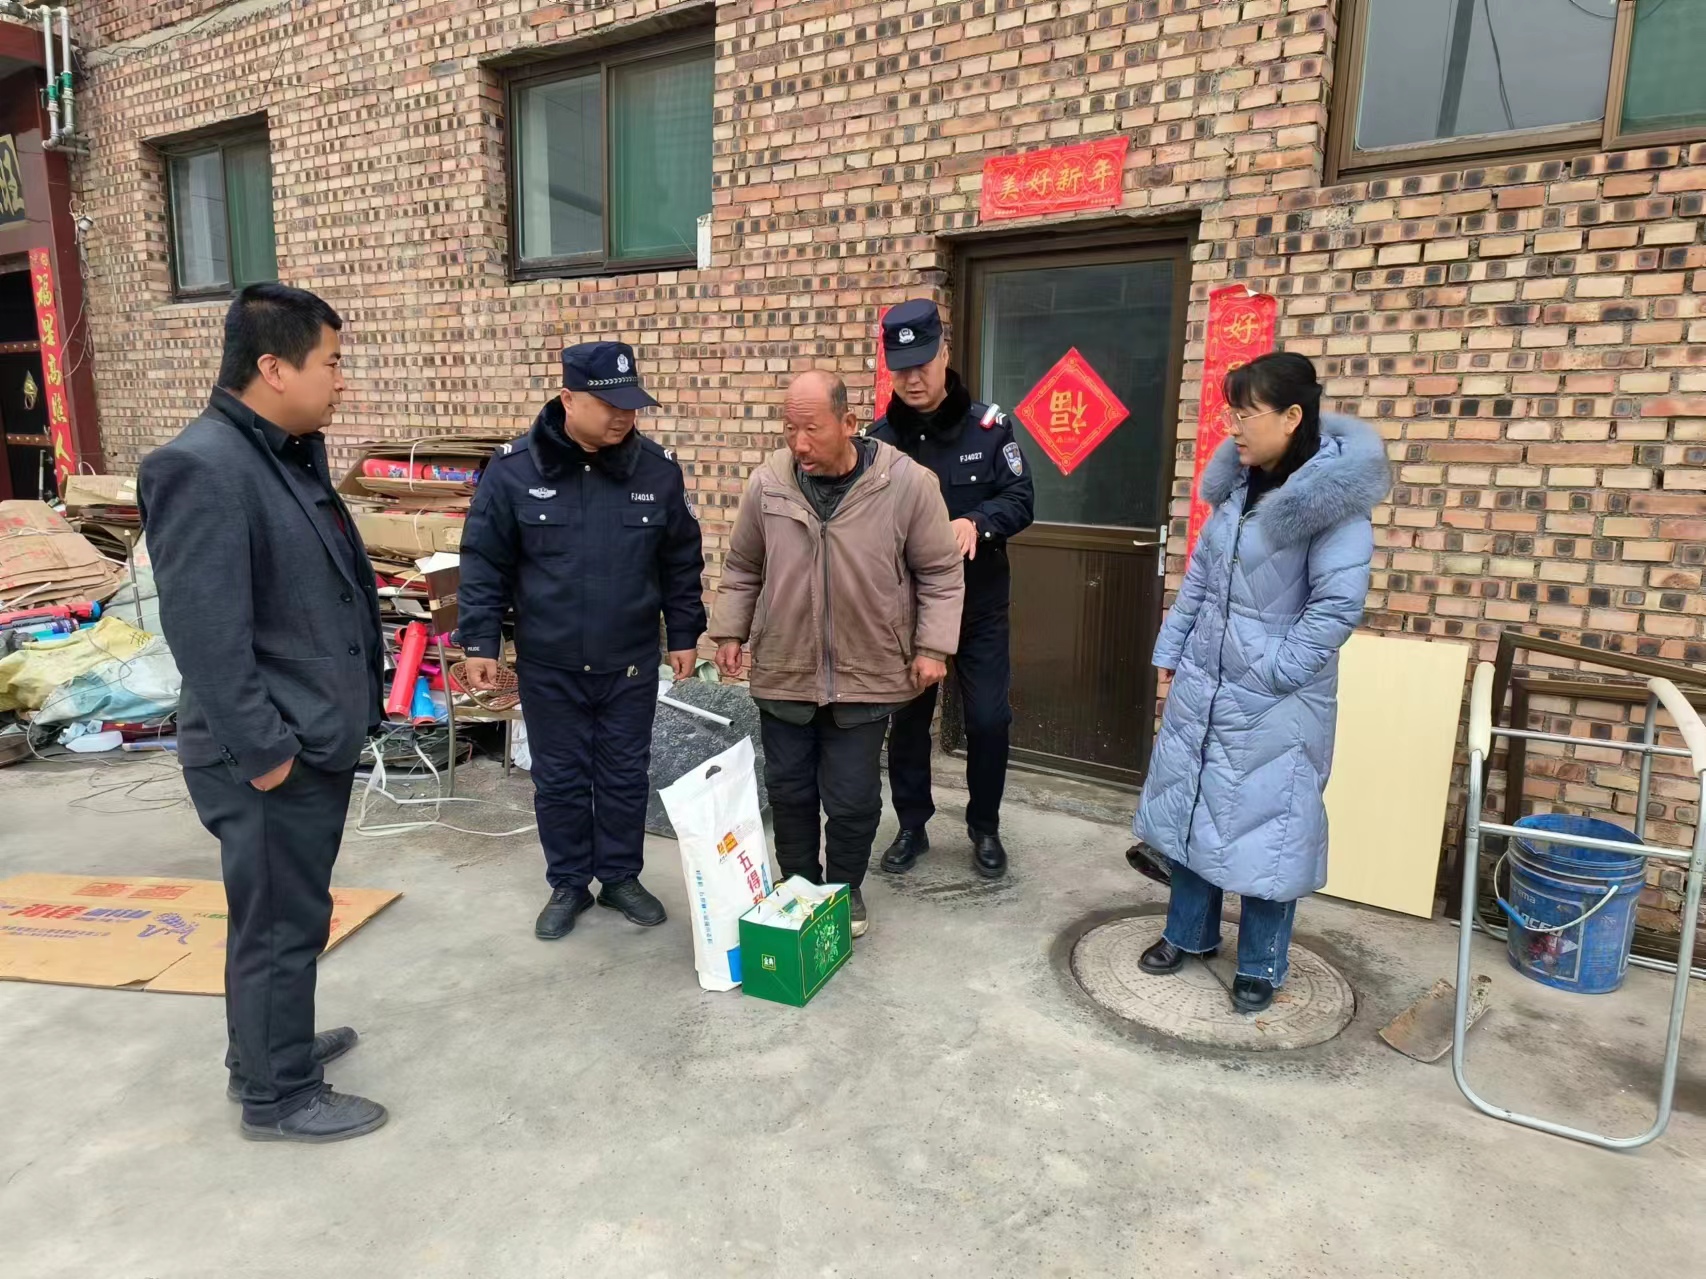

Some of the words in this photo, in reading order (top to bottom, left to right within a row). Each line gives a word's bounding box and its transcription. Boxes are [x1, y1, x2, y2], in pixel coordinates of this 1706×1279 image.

[999, 157, 1115, 201] 美好新年
[1049, 390, 1089, 435] 福
[959, 451, 983, 463] FJ4027
[630, 492, 655, 501] FJ4016
